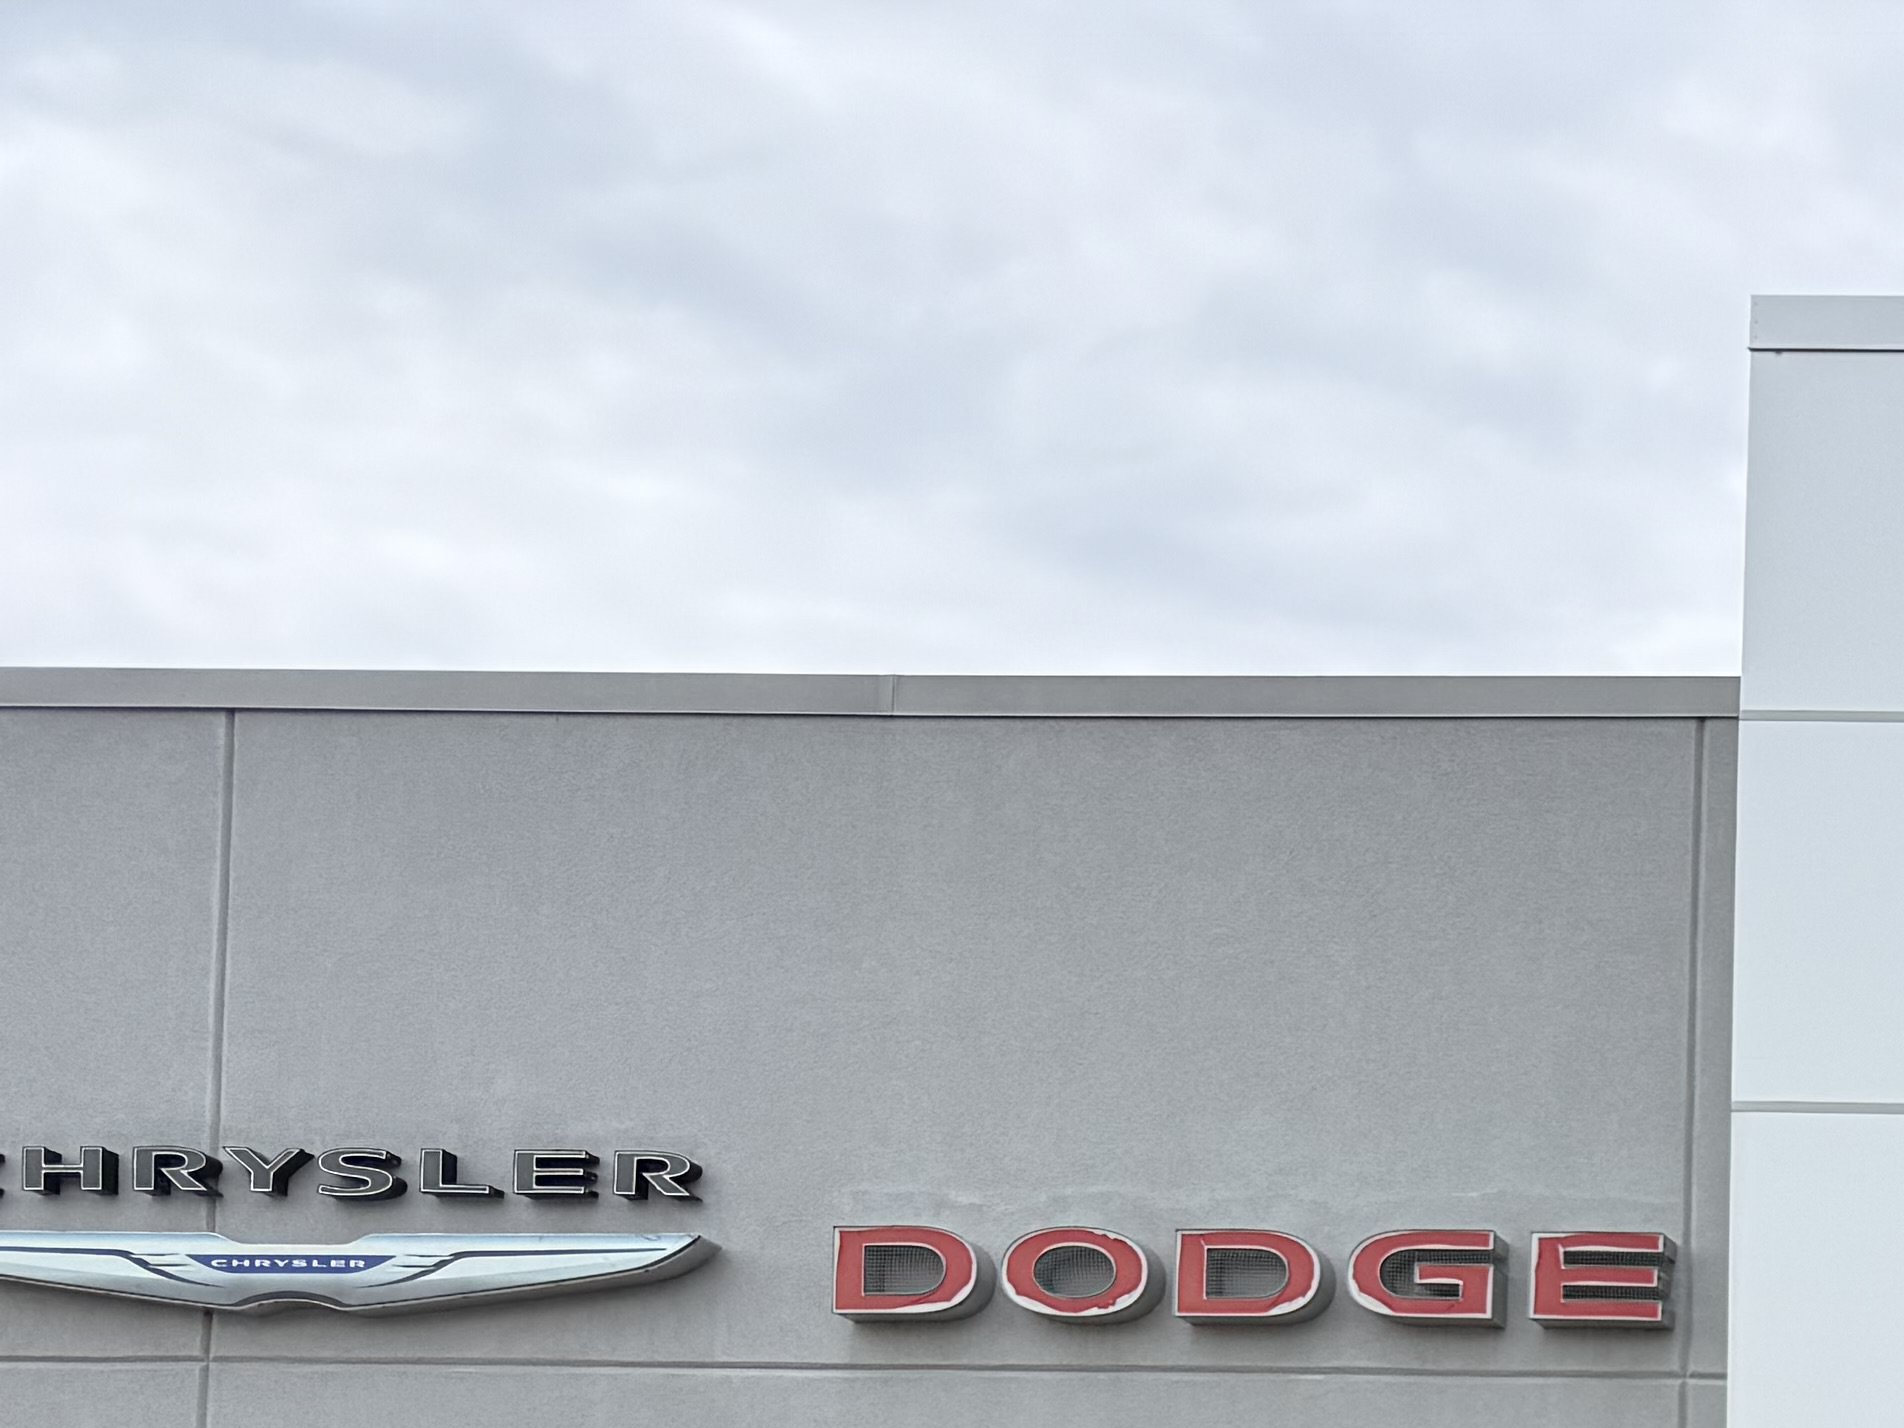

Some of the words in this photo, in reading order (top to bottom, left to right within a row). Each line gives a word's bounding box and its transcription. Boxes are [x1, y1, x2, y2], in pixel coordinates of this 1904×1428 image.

[0, 1145, 702, 1201] HRYSLER
[210, 1258, 366, 1268] CHRYSLER
[831, 1225, 1675, 1329] DODGE
